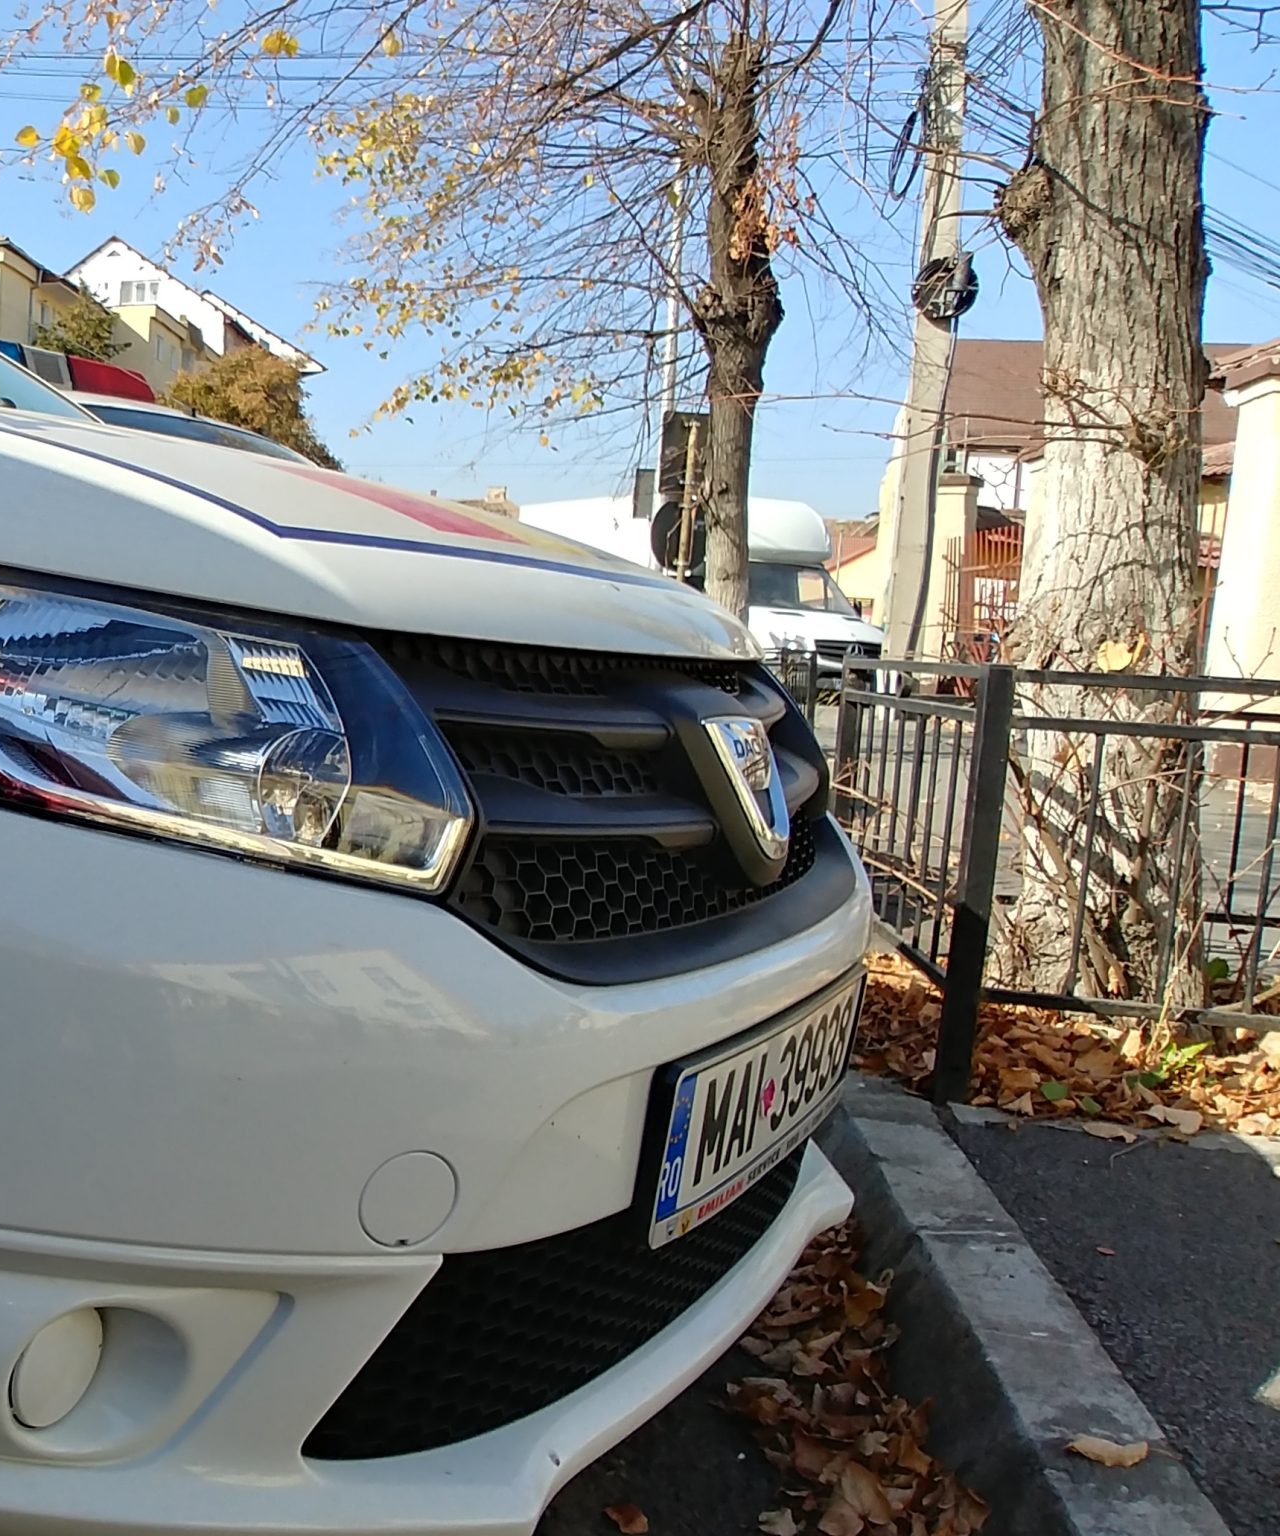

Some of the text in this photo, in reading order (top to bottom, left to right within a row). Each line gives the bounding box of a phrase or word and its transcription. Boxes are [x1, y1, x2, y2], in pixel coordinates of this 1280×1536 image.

[733, 737, 768, 759] DAC
[692, 1051, 768, 1187] MAI
[770, 994, 854, 1132] 39938
[659, 1156, 682, 1202] RO
[697, 1147, 781, 1220] EMILIAN SERVICE
